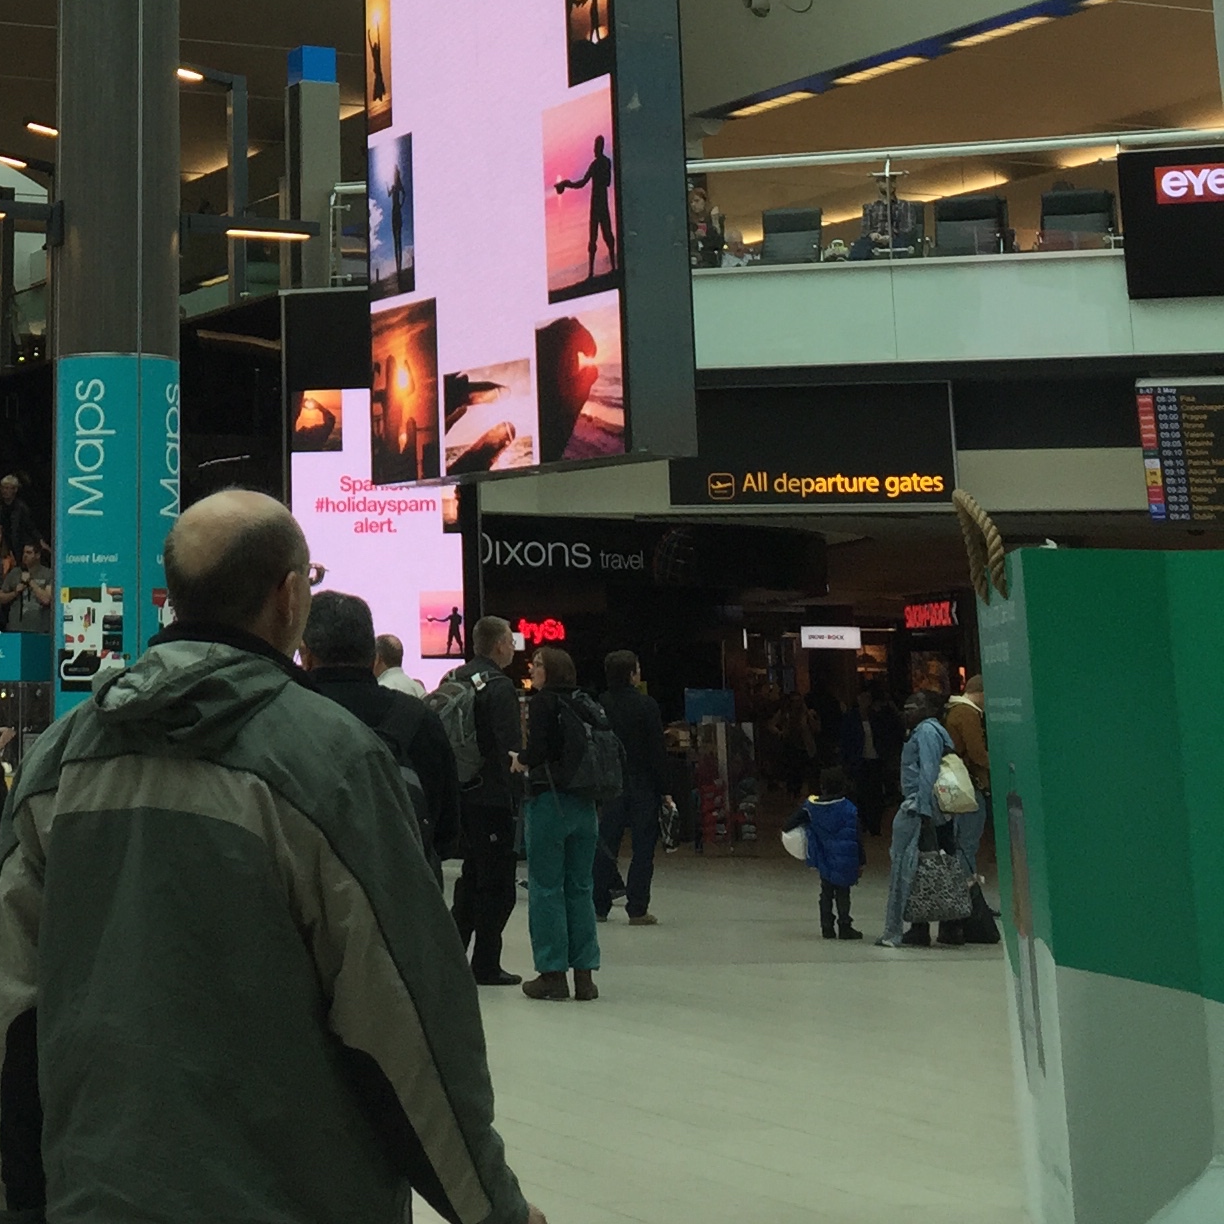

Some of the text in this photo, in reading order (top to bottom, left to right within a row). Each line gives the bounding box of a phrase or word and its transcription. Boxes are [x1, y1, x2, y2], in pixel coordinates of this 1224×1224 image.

[68, 379, 116, 516] Maps
[742, 472, 944, 498] All departure gates
[315, 497, 437, 516] #holidayspam
[353, 518, 398, 534] alert.
[599, 550, 644, 570] travel
